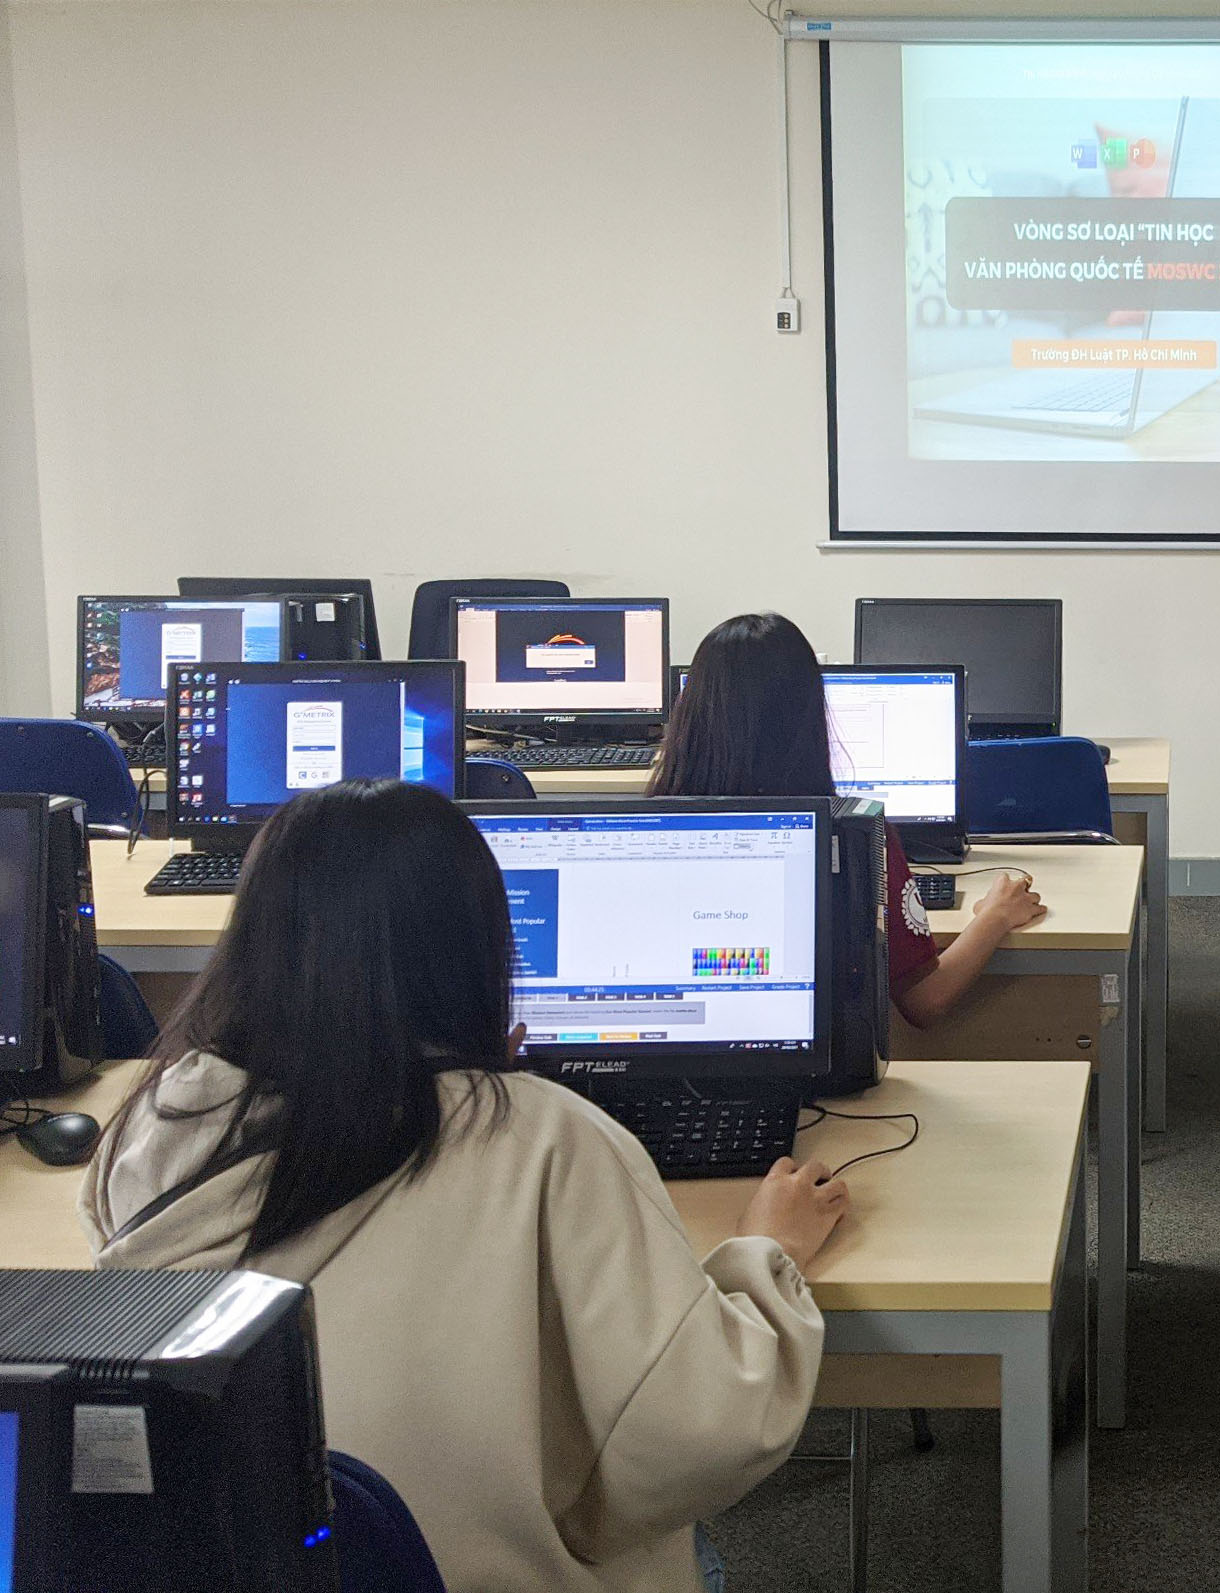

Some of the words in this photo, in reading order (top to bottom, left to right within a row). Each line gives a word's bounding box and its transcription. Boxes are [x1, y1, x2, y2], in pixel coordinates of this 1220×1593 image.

[1013, 219, 1063, 241] VÒNG
[1067, 220, 1091, 241] SƠ
[1095, 223, 1134, 246] LOẠI
[1176, 223, 1214, 246] HỌC
[964, 257, 1001, 280] VĂN
[1005, 258, 1066, 280] PHÒNG
[1070, 255, 1119, 281] QUỐC
[1123, 256, 1143, 280] TẾ
[1071, 349, 1087, 361] ĐH
[1090, 349, 1113, 363] Luật
[1115, 349, 1131, 361] TP.
[1133, 348, 1148, 361] Hồ
[1170, 349, 1197, 361] Minh
[693, 910, 722, 920] Game
[723, 909, 749, 921] Shop
[561, 1062, 594, 1073] FPT
